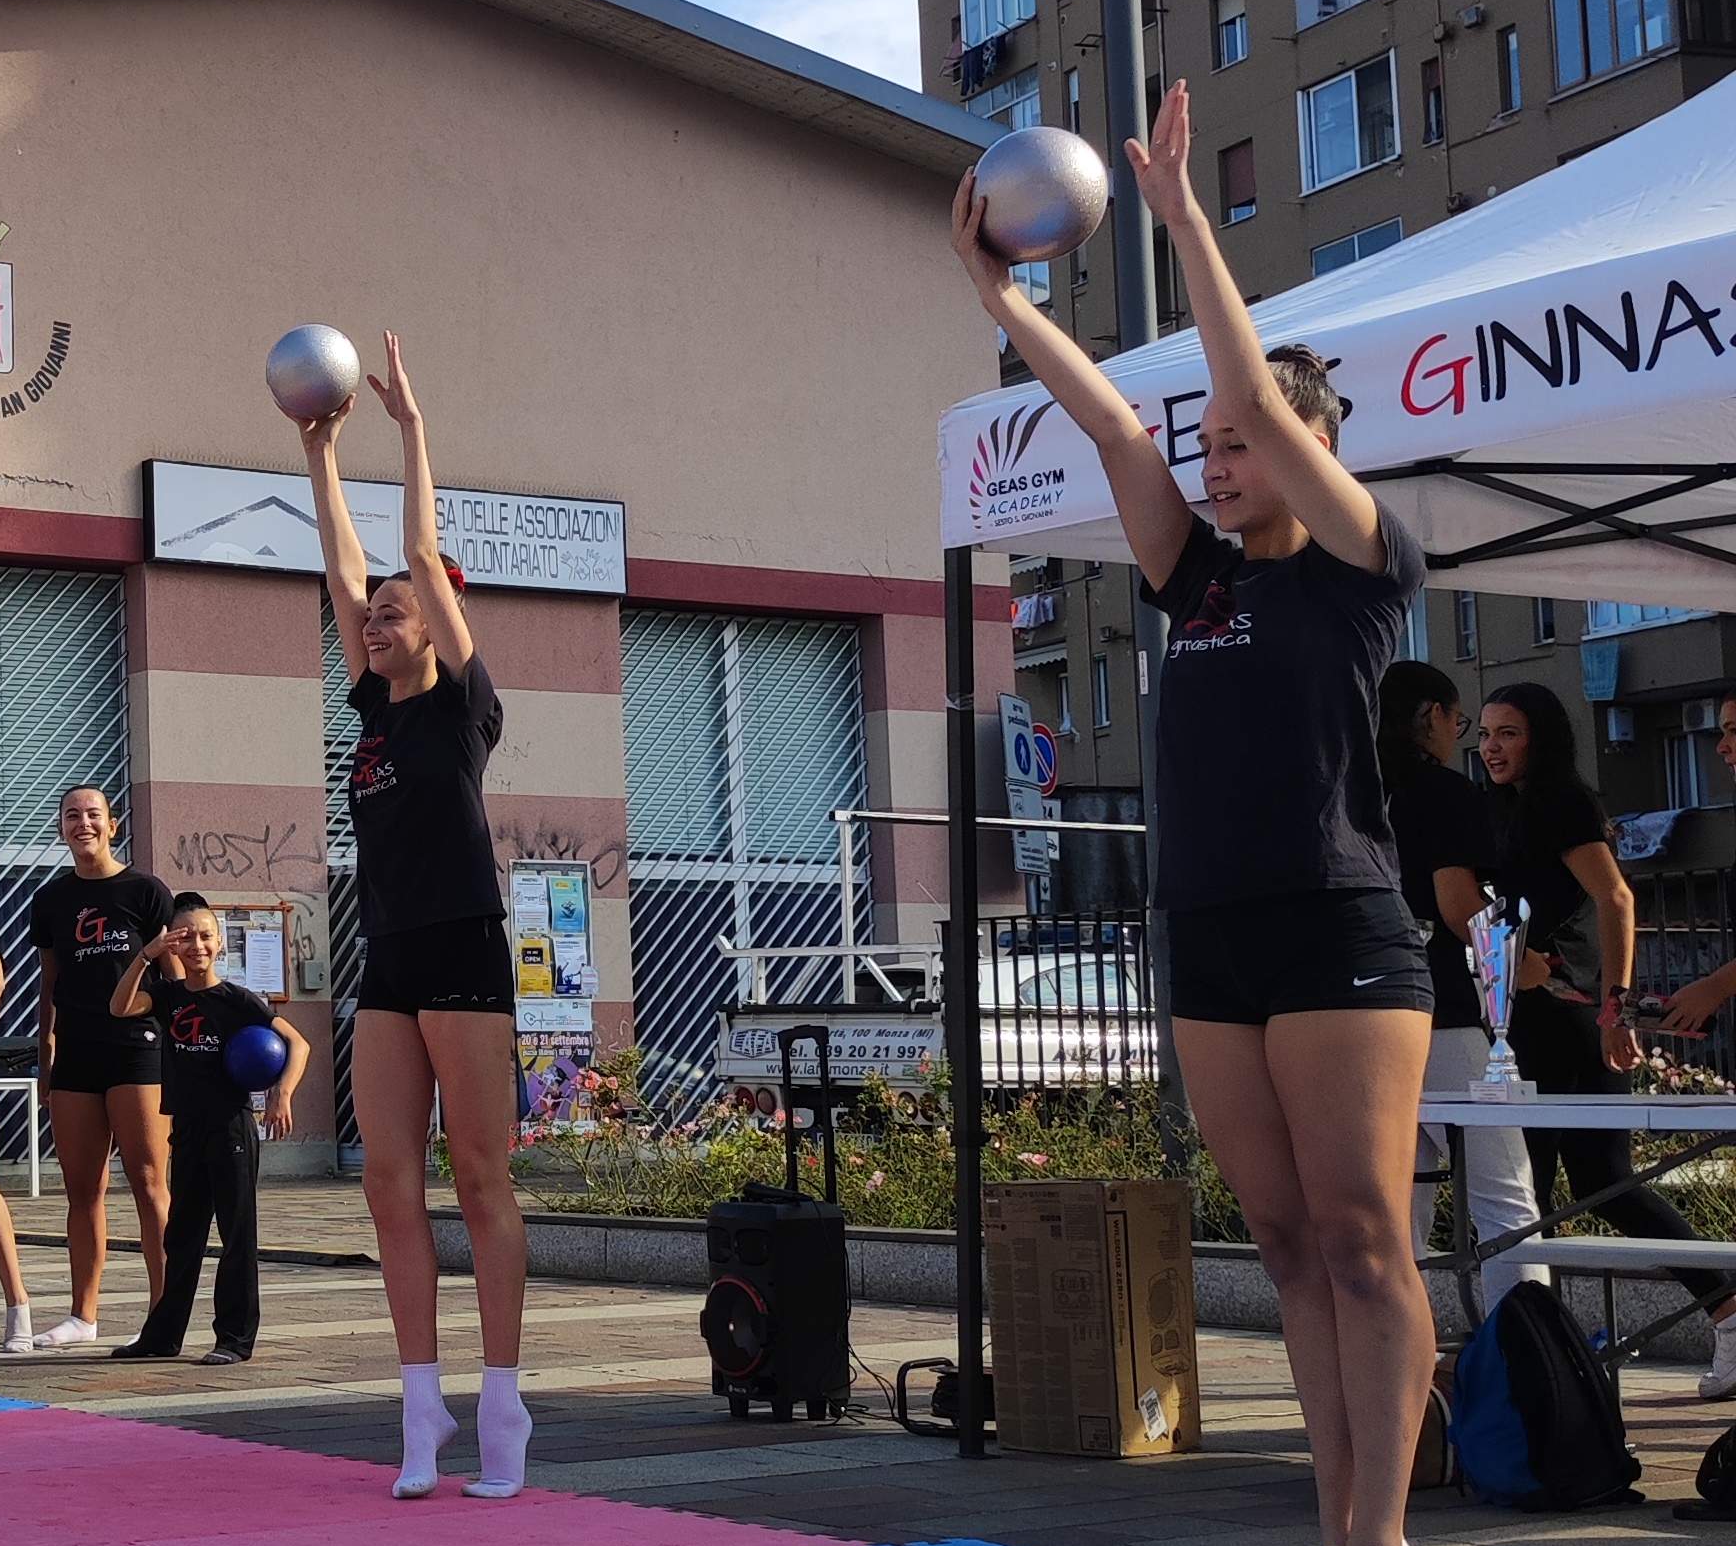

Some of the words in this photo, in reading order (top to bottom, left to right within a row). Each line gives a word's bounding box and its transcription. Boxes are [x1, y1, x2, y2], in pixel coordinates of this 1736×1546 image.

[23, 320, 72, 403] GIOVANNI
[1400, 279, 1735, 417] GINNA
[986, 475, 1028, 497] GEAS
[1031, 467, 1065, 489] GYM
[987, 489, 1064, 517] ACADEMY
[435, 497, 457, 532] SA
[462, 499, 509, 536] DELLE
[514, 503, 620, 543] ASSOCIAZIONI
[455, 537, 559, 579] VOLONTARIATO
[75, 908, 129, 943] GEAS
[875, 1029, 910, 1038] Monza
[789, 1045, 808, 1058] el.
[848, 1045, 866, 1058] 20
[872, 1045, 890, 1058] 21
[897, 1045, 927, 1058] 997
[766, 1062, 890, 1076] www.lafmonzait
